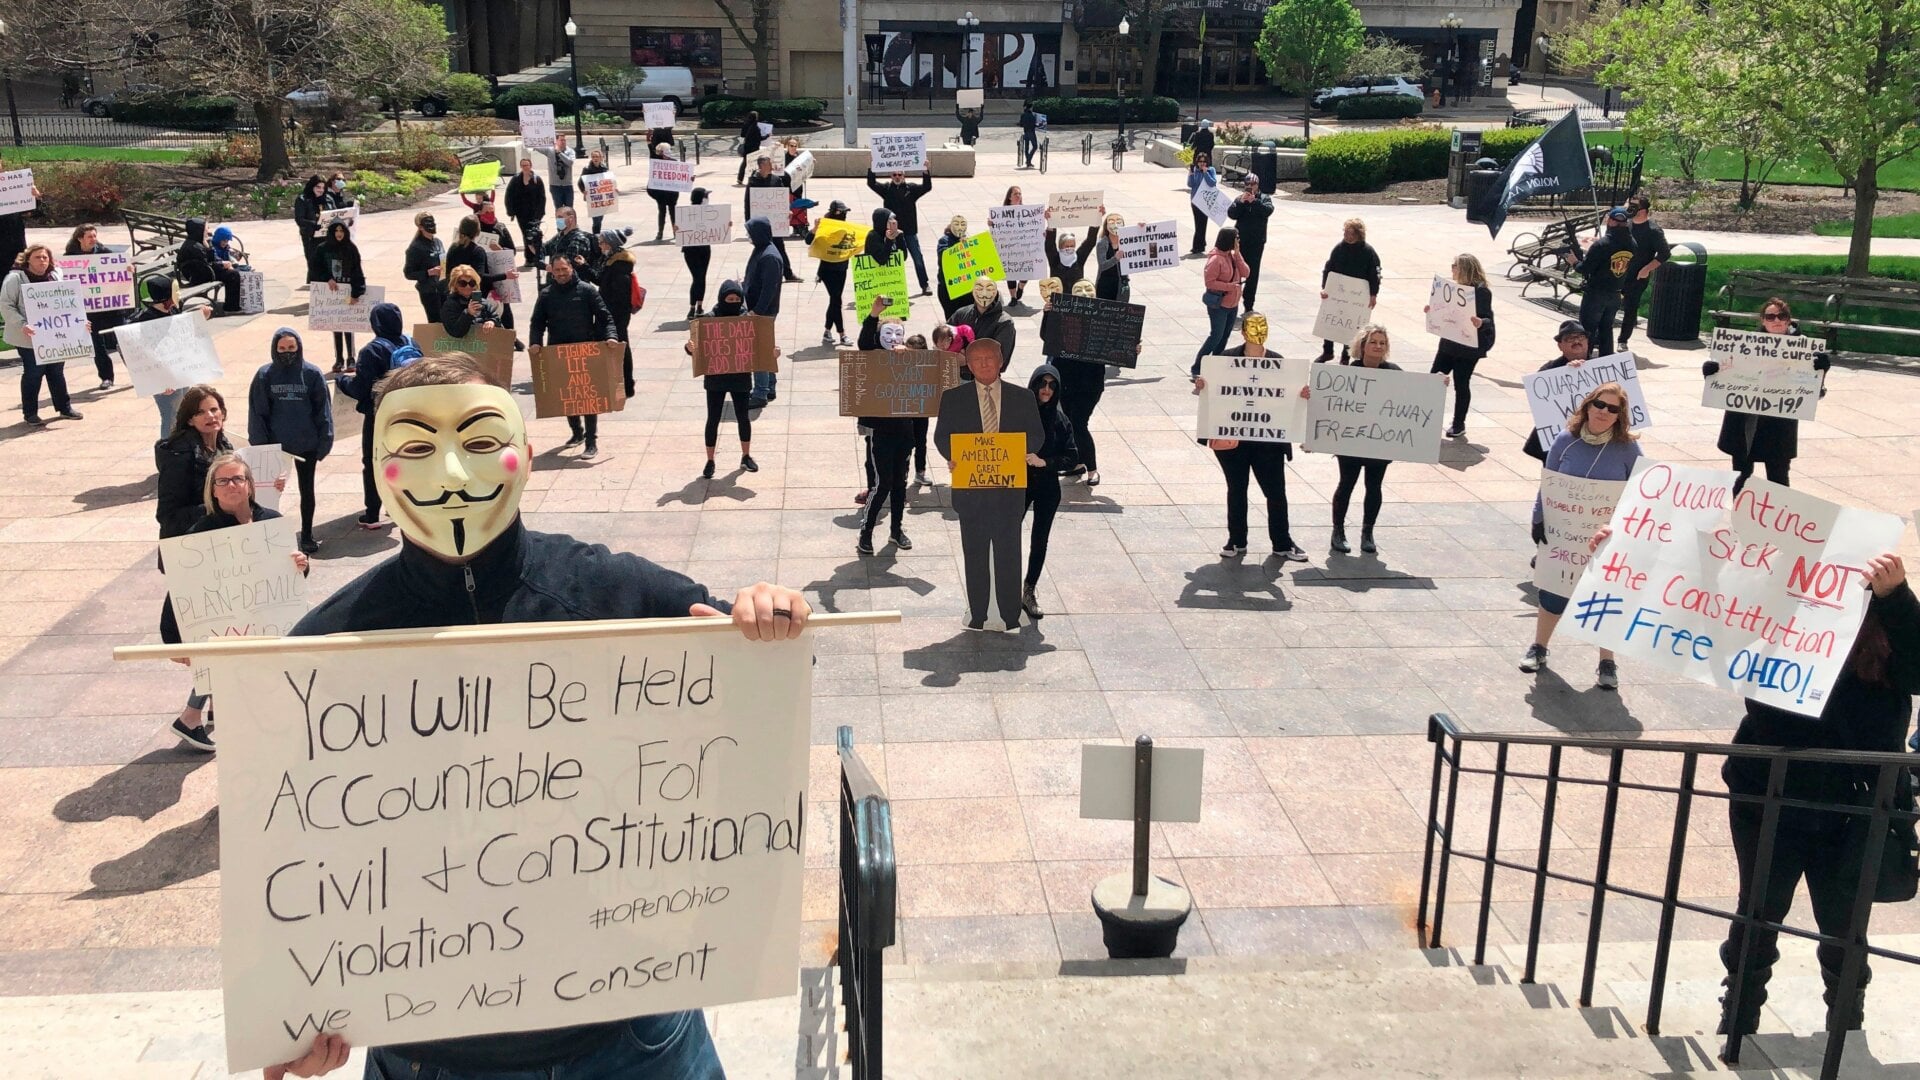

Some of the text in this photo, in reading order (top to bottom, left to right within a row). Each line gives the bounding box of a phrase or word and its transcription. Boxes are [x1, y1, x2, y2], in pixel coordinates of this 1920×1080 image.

[1183, 1, 1201, 9] WILL
[1243, 2, 1257, 12] LES
[1486, 39, 1495, 64] CENTER
[652, 170, 690, 183] FREEDOM!
[679, 207, 720, 221] THIS
[1002, 209, 1015, 219] AMY
[1146, 225, 1157, 233] MY
[1119, 230, 1178, 245] CONSTITUTIONAL
[949, 239, 979, 256] BALANCE
[957, 250, 971, 259] THE
[1159, 245, 1174, 253] ARE
[101, 254, 127, 265] Job
[854, 255, 876, 271] ALL
[1129, 259, 1173, 270] ESSENTIAL
[975, 267, 995, 278] OHIO
[89, 287, 101, 295] TO
[38, 301, 48, 309] the
[1053, 293, 1095, 308] Worldwide
[43, 314, 71, 329] NOT
[55, 330, 67, 339] the
[703, 321, 756, 339] THE DATA
[704, 338, 753, 357] DOES NOT
[1717, 329, 1825, 351] How many will be
[556, 343, 601, 359] FIGURES
[1712, 341, 1735, 353] lost
[1740, 346, 1751, 355] to
[1755, 346, 1777, 357] the
[567, 358, 589, 373] LIE
[708, 355, 730, 374] ADD
[1230, 358, 1282, 370] ACTON
[569, 372, 591, 386] AND
[891, 366, 924, 381] WHEN
[1533, 360, 1637, 402] QUARANTINE
[875, 383, 938, 399] GOVERNMENT
[1315, 370, 1377, 397] DONT
[1710, 381, 1725, 390] the
[559, 385, 597, 401] LIARS
[1220, 386, 1285, 398] DEWINE
[564, 397, 608, 415] FIGURE!
[1726, 393, 1804, 414] COVID-19!
[1231, 411, 1271, 424] OHIO
[1326, 395, 1433, 428] TAKE AWAY
[975, 436, 995, 446] MAKE
[1218, 427, 1286, 440] DECLINE
[1314, 419, 1414, 448] FREEDOM
[961, 448, 1009, 461] AMERICA
[976, 464, 1001, 474] GREAT
[969, 473, 1016, 488] AGAIN!
[1546, 497, 1584, 515] DISABLED
[1622, 507, 1672, 543] the
[1564, 532, 1592, 543] CONST
[213, 564, 252, 592] your
[1787, 556, 1863, 602] NOT
[175, 571, 304, 622] PLAN-DEMIC
[1602, 552, 1835, 659] the Constitution
[1728, 649, 1814, 705] OHIO!
[285, 668, 389, 760] You
[528, 662, 588, 730] Be
[615, 651, 715, 715] Held
[638, 736, 738, 806] For
[266, 847, 389, 922] Civil
[288, 906, 525, 988] Violations
[283, 942, 718, 1043] We Do Not Consent
